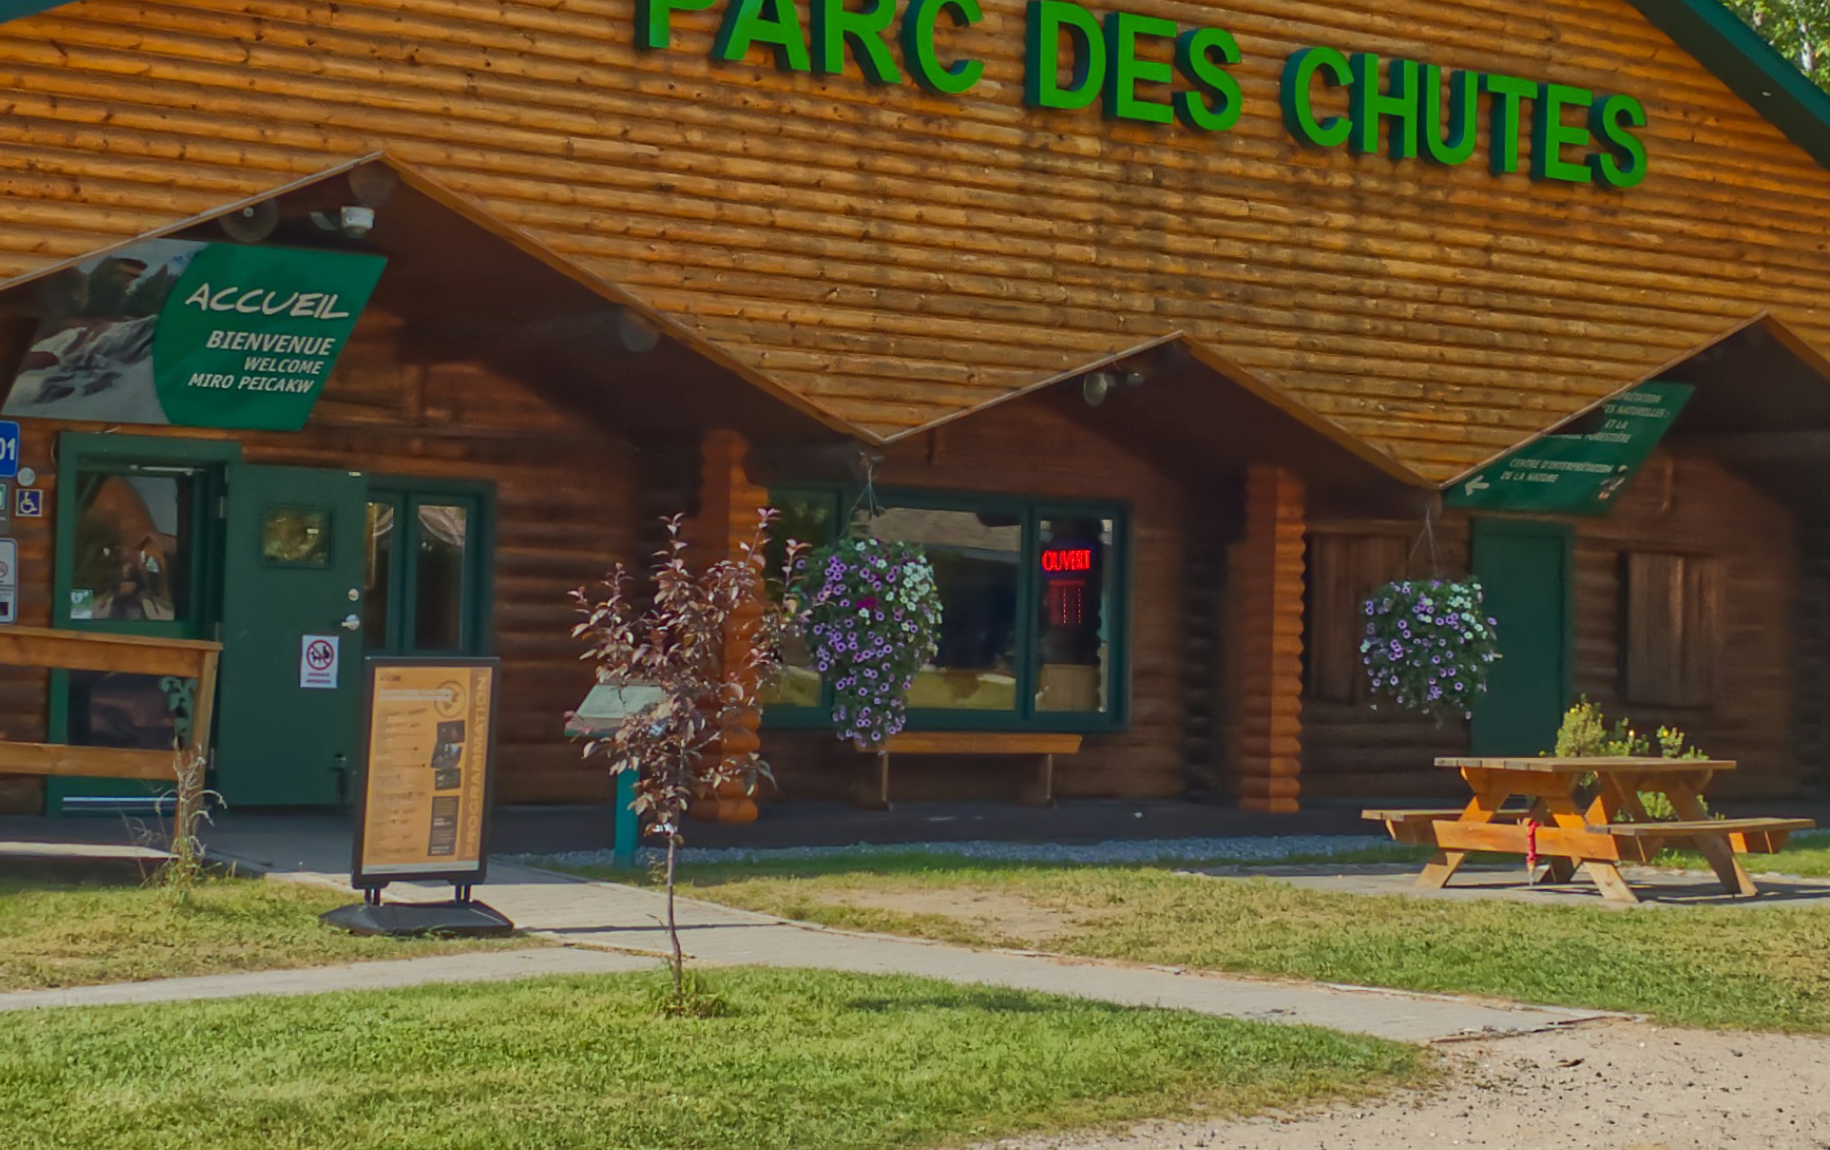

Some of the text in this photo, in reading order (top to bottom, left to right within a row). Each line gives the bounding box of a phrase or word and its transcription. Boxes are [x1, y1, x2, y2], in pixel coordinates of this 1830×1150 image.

[1024, 0, 1243, 133] DES
[1280, 45, 1648, 189] CHUTES
[185, 282, 350, 320] ACCUEIL
[205, 330, 336, 356] BIENVENUE
[243, 356, 324, 375] WELCOME
[187, 372, 315, 393] MIRO PEICAKW
[466, 676, 487, 856] PROGRAMMATION
